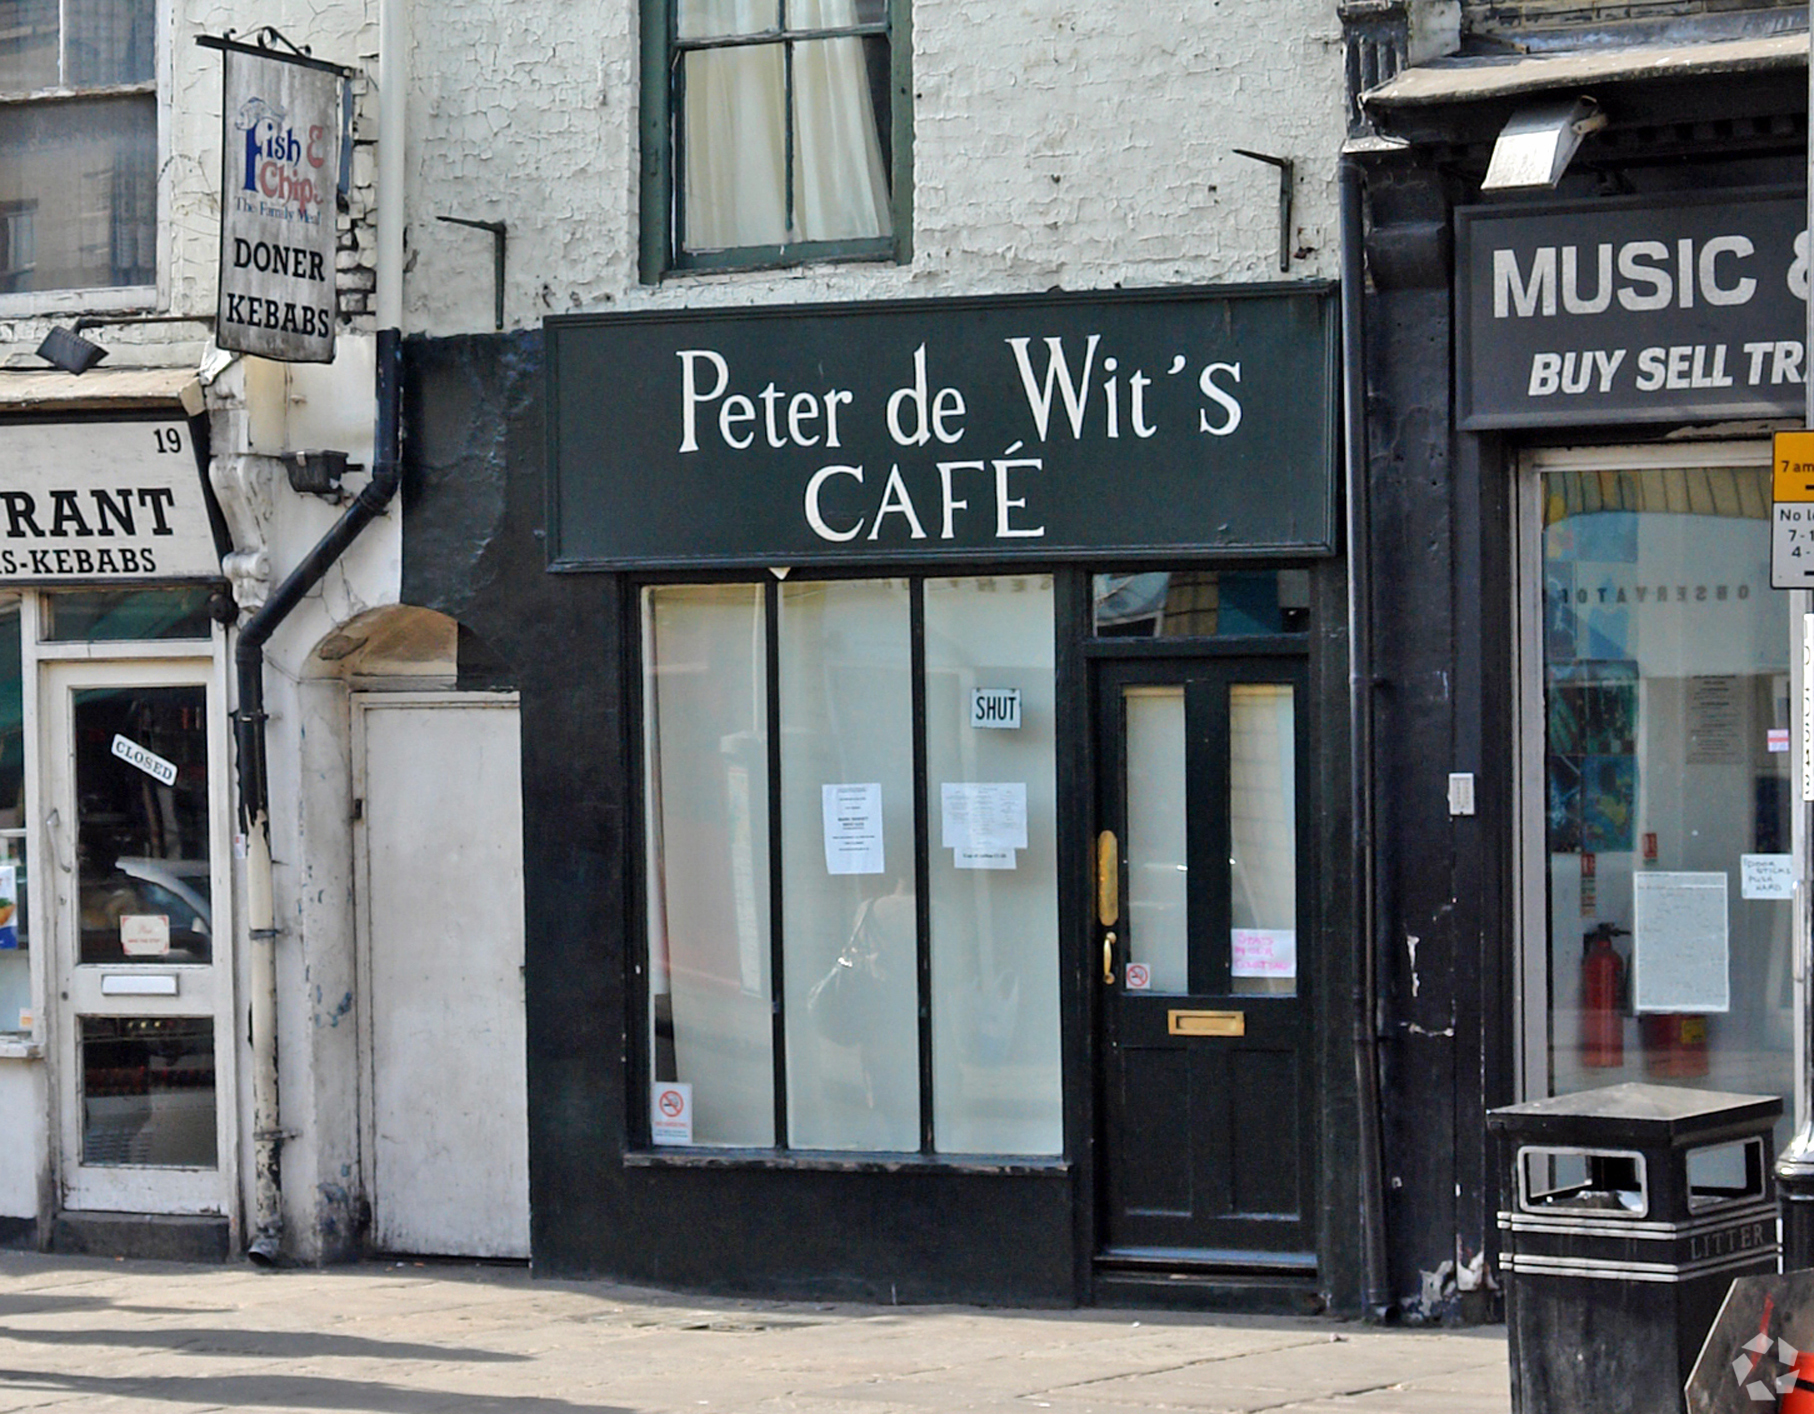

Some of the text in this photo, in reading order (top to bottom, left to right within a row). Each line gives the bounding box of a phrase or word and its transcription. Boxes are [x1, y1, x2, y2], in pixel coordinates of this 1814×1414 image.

[242, 117, 301, 192] Fish
[235, 196, 256, 213] The
[260, 201, 294, 220] Family
[233, 236, 326, 283] DONER
[1492, 234, 1758, 319] MUSIC
[226, 292, 330, 339] KEBABS
[1528, 340, 1808, 396] BUY SELL TR
[675, 349, 854, 454] Peter
[885, 341, 967, 448] de
[153, 427, 182, 453] 19
[1781, 461, 1789, 472] 7
[803, 440, 1046, 543] CAFÉ
[0, 487, 176, 538] RANT
[1779, 508, 1801, 522] No
[1788, 529, 1797, 542] 7
[1791, 546, 1802, 558] 4
[0, 548, 157, 574] S-KEBABS
[975, 696, 1017, 721] SHUT
[115, 741, 173, 780] CLOSED
[1690, 1223, 1764, 1260] LITTER
